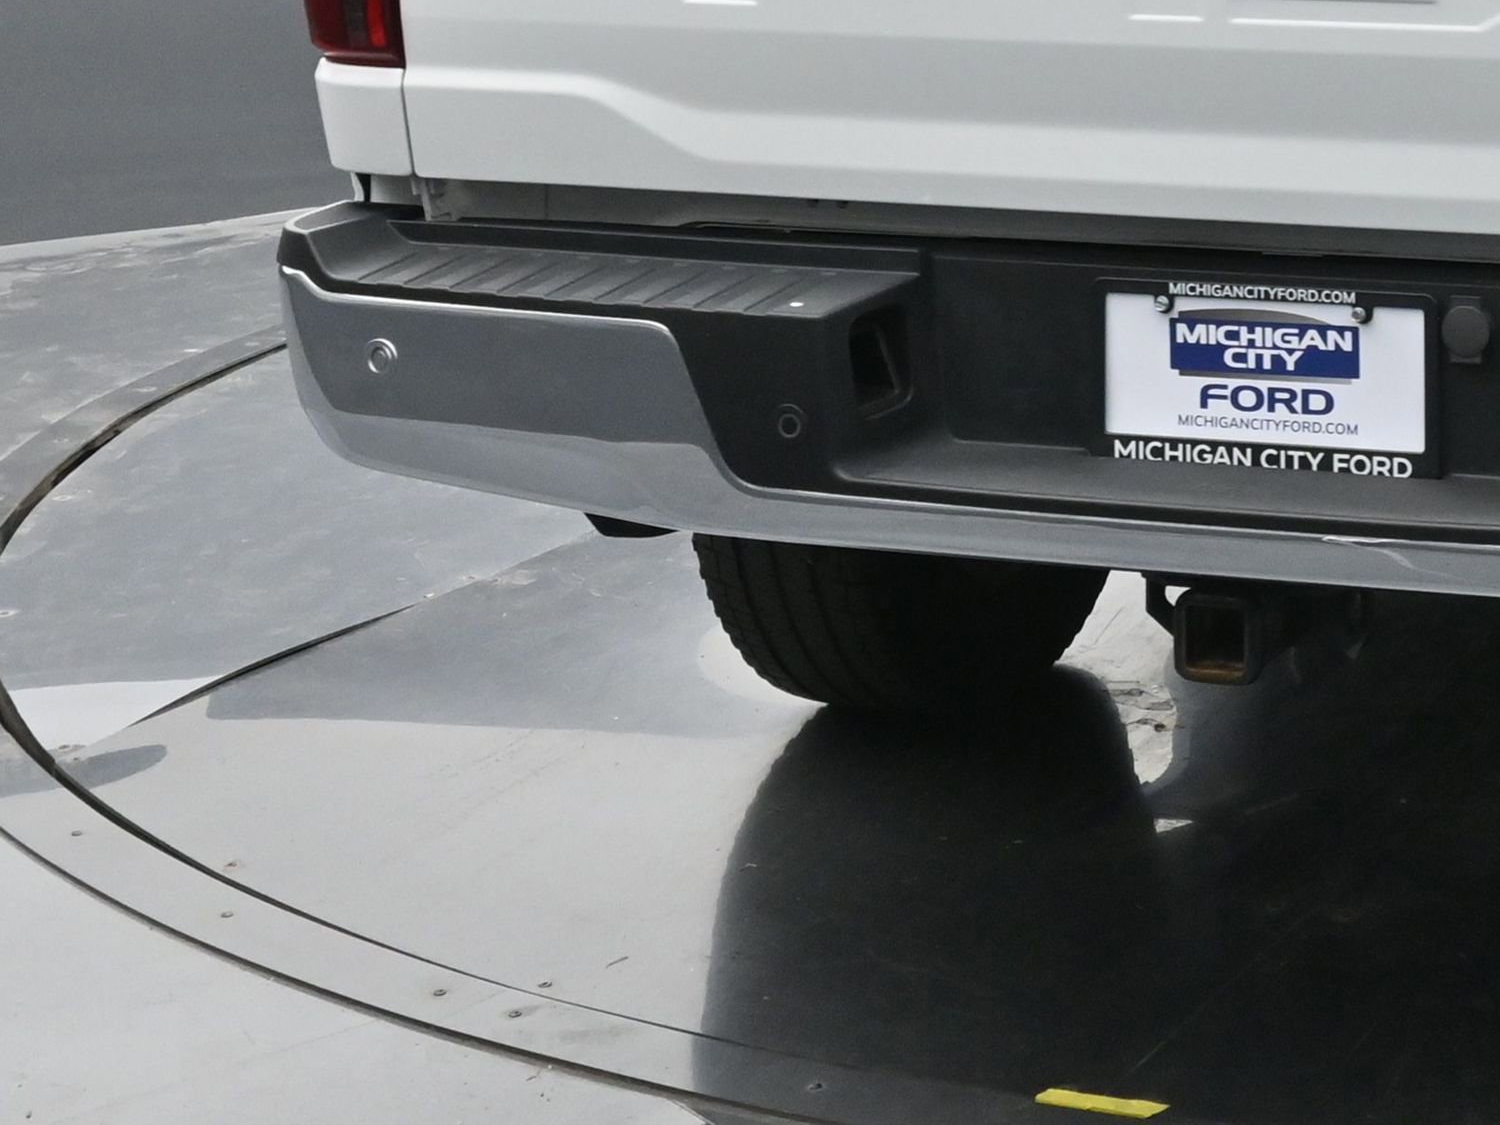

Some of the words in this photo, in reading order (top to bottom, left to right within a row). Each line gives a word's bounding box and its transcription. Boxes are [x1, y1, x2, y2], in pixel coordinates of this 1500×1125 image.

[1168, 282, 1356, 305] MICHIGANCITYFORD.COM
[1175, 322, 1352, 352] MICHIGAN
[1223, 347, 1304, 371] CITY
[1200, 383, 1335, 416] FORD
[1178, 413, 1359, 436] MICHIGANCITYFORD.COM
[1113, 439, 1253, 467] MICHIGAN
[1260, 448, 1325, 472] CITY
[1333, 453, 1413, 479] FORD
